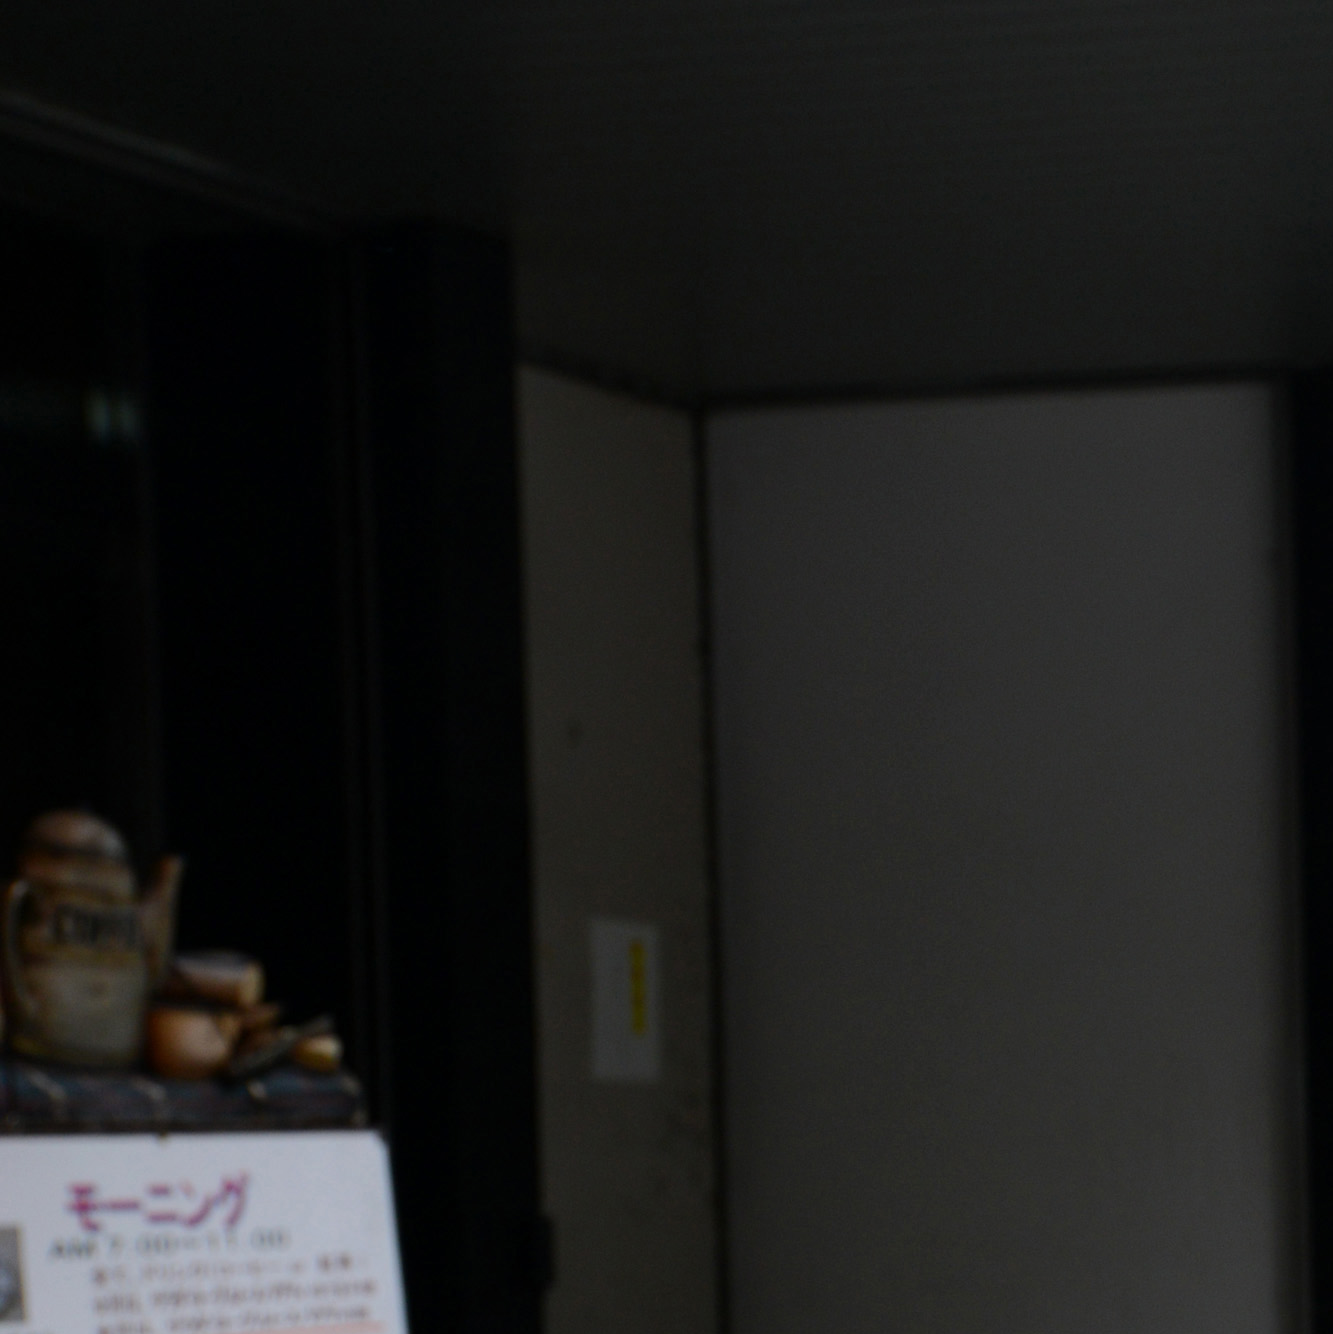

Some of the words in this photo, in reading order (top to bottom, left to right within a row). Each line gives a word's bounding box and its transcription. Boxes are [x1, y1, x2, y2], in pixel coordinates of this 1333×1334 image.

[67, 1171, 249, 1231] モーニング
